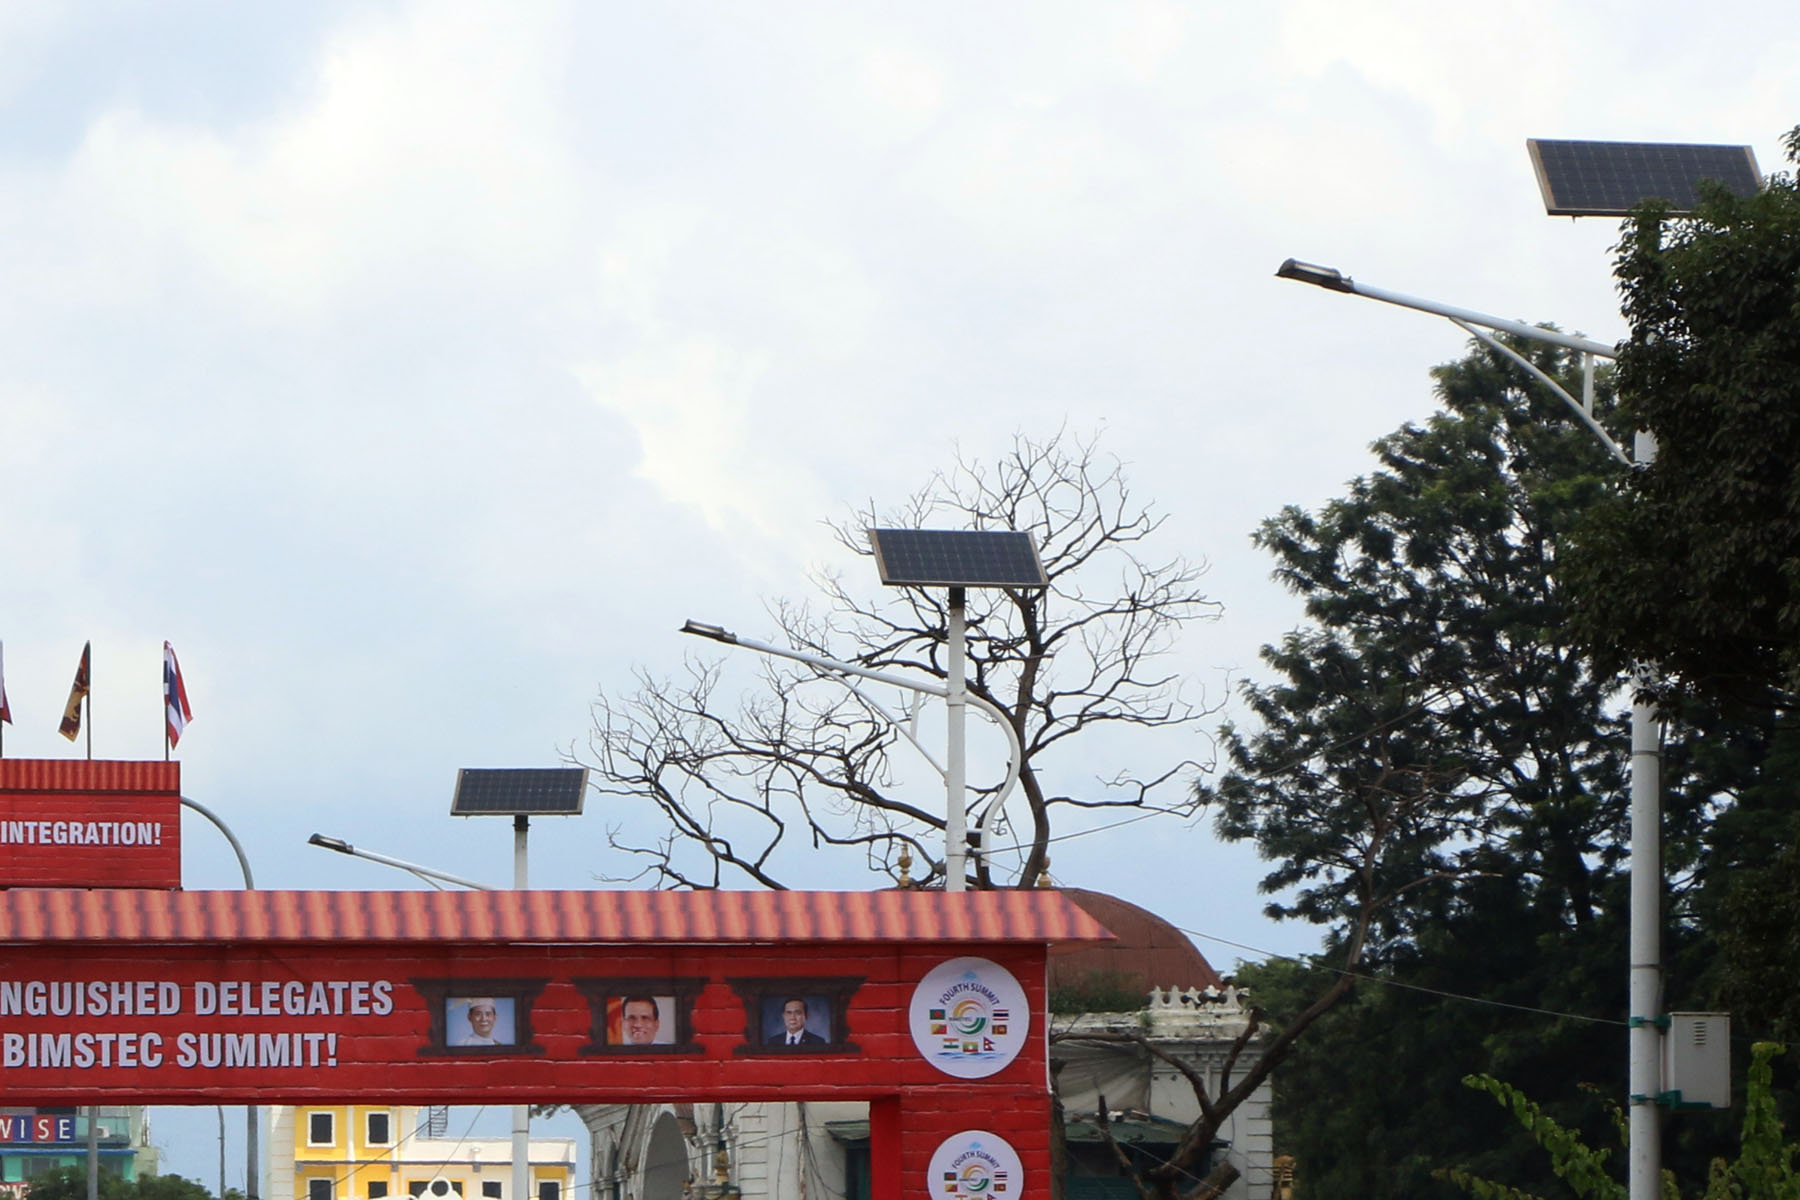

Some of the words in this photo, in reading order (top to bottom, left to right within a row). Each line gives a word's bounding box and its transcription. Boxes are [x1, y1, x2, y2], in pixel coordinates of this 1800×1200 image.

[0, 820, 161, 845] INTEGRATION!
[194, 980, 394, 1015] DELEGATES
[939, 982, 970, 1006] FOURTH
[970, 982, 1000, 1006] SUMMIT
[3, 1032, 163, 1068] BIMSTEC
[176, 1032, 337, 1068] SUMMIT!
